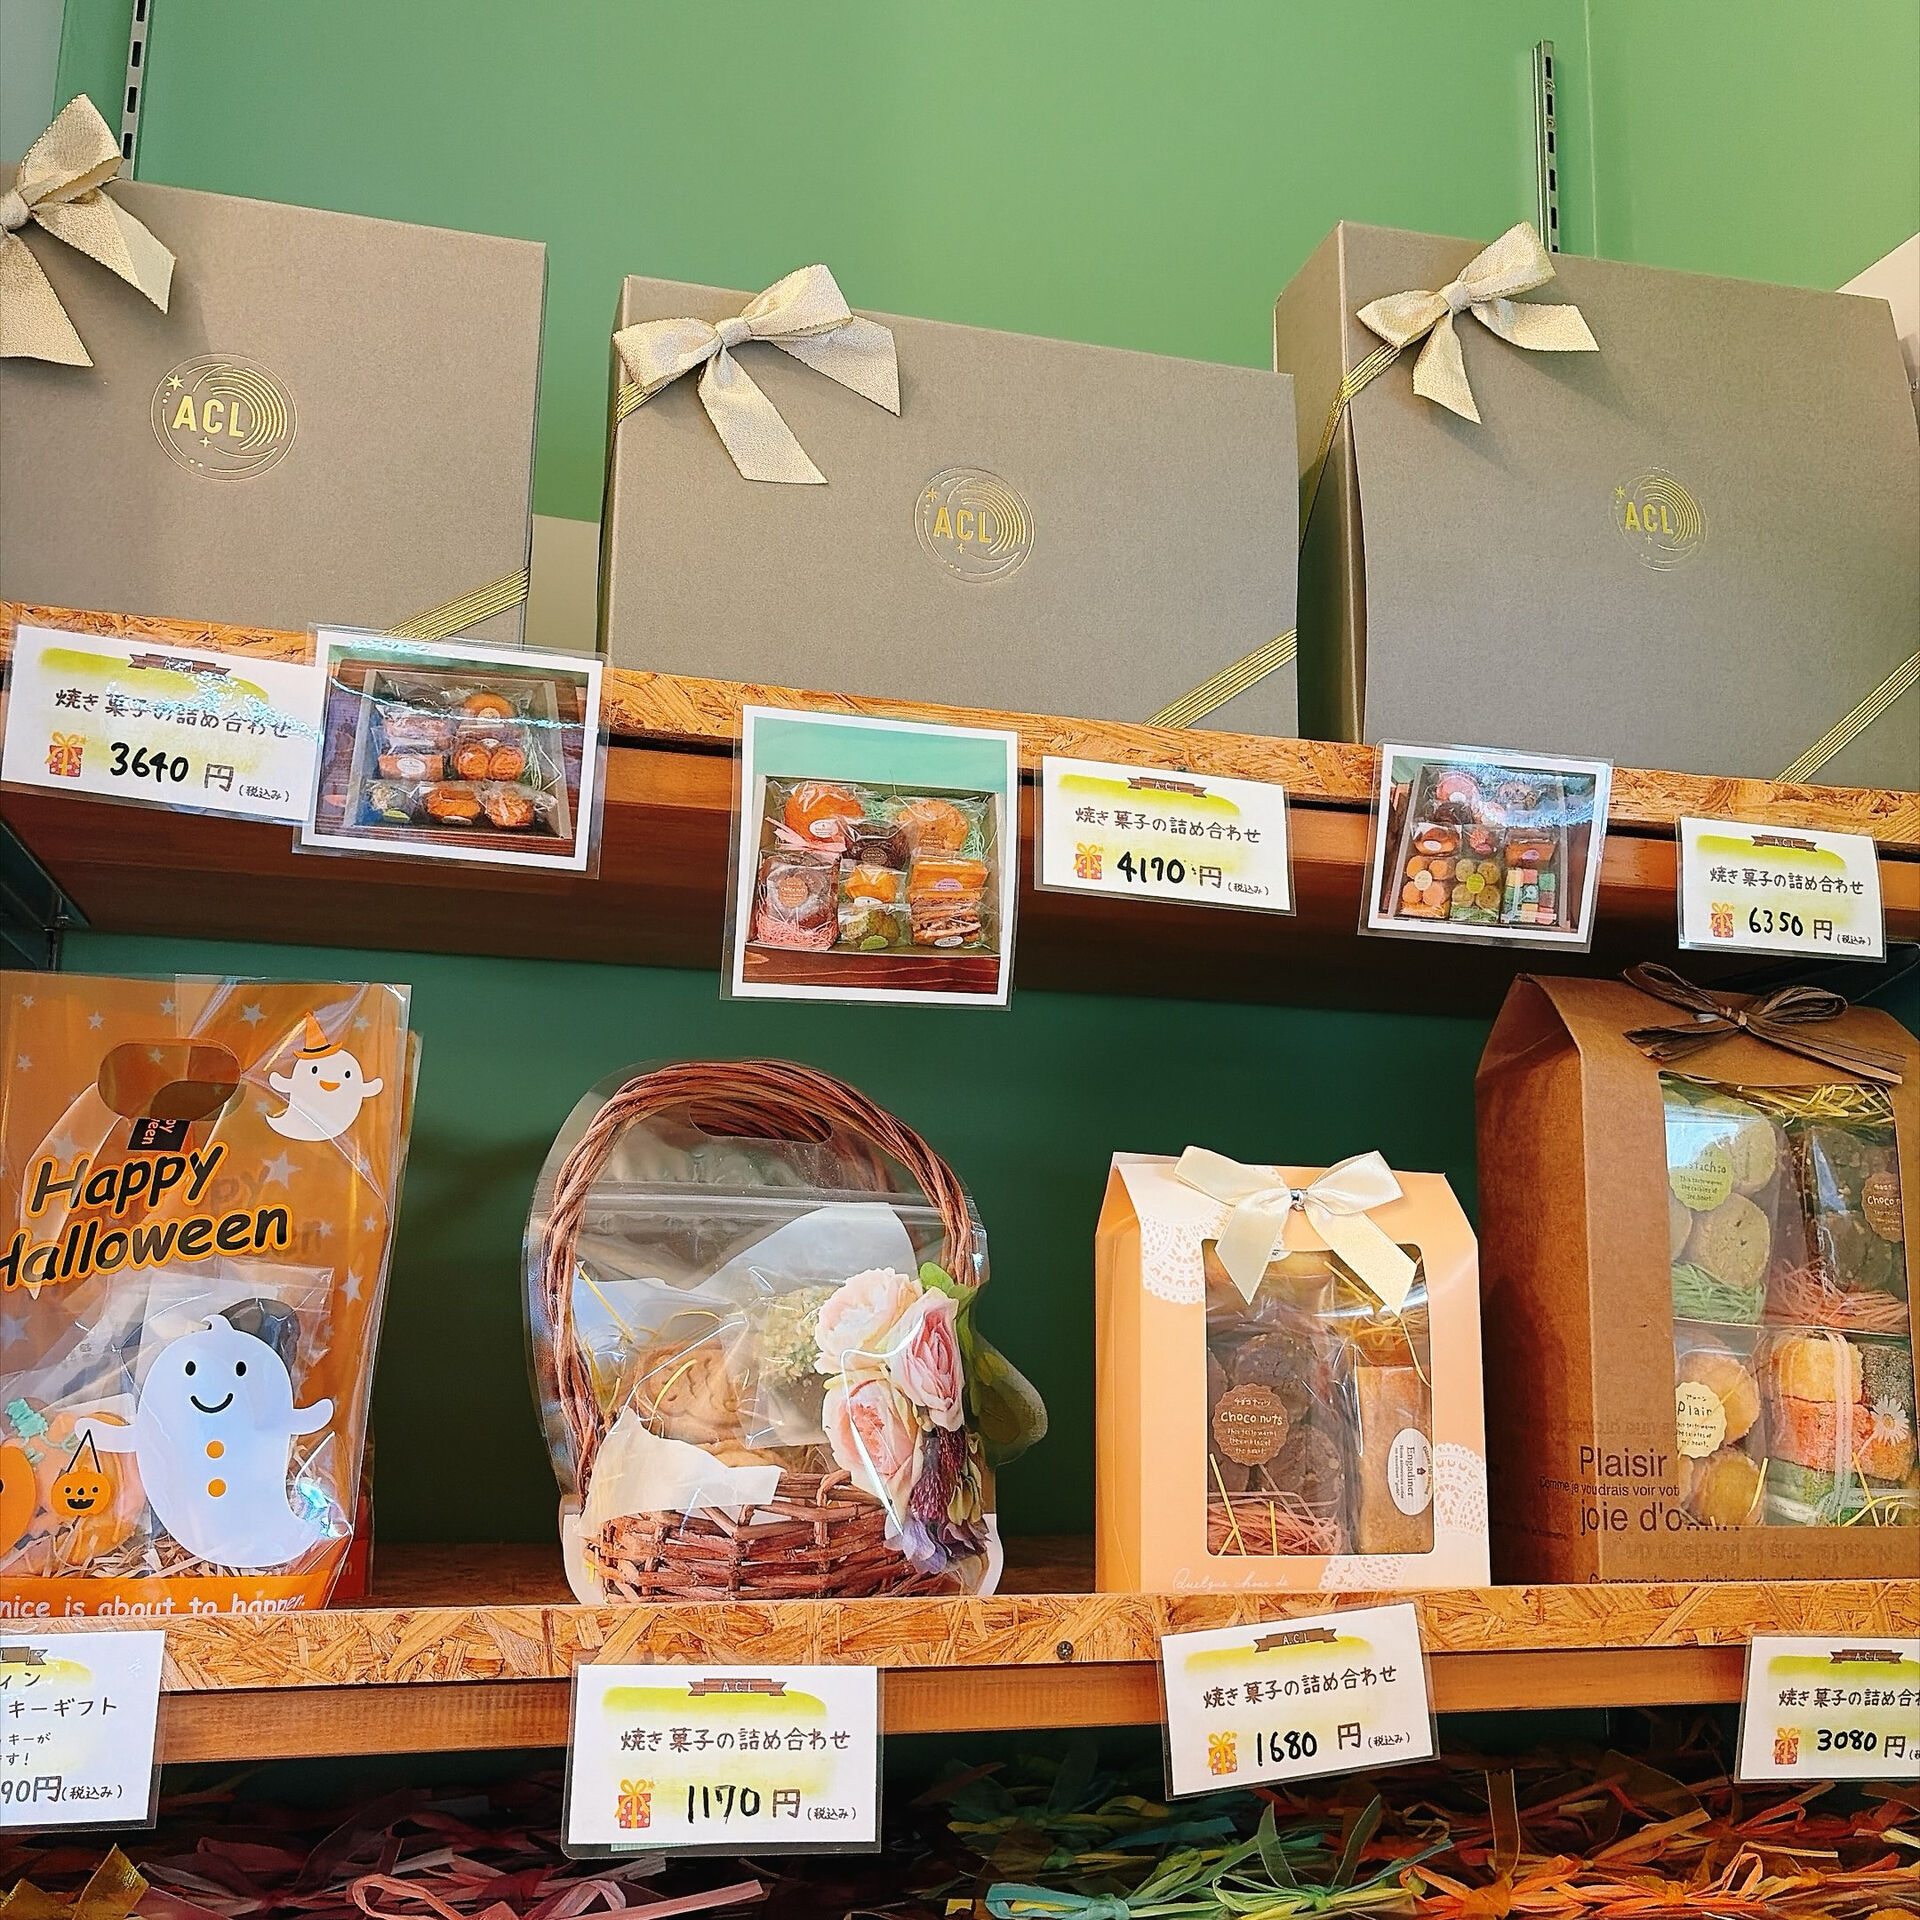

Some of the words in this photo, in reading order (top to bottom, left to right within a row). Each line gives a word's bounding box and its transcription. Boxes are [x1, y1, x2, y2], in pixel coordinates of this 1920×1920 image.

[172, 395, 245, 438] ACL
[933, 506, 992, 543] ACL
[1624, 501, 1674, 535] ACL
[109, 741, 189, 784] 3640
[203, 763, 235, 792] 円
[1074, 806, 1262, 844] 焼き菓子の詰め合わせ
[1116, 851, 1186, 884] 4170
[1198, 865, 1223, 889] 円
[1709, 866, 1864, 895] 焼き菓子の詰め合わせ
[1748, 907, 1804, 937] 6350
[1812, 919, 1833, 941] 円
[29, 1144, 226, 1216] Happy
[1220, 1410, 1257, 1424] Choco
[1260, 1413, 1283, 1426] nuts
[1579, 1445, 1668, 1477] Plaisir
[1581, 1484, 1629, 1496] voudrais
[1634, 1484, 1656, 1496] voir
[1580, 1500, 1628, 1536] joie
[64, 1595, 85, 1617] is
[98, 1595, 176, 1617] about
[189, 1596, 217, 1616] to
[1202, 1665, 1397, 1709] 焼き菓子の詰め合わせ
[620, 1727, 851, 1752] 焼き菓子の詰め合わせ
[1256, 1730, 1318, 1767] 1680
[1337, 1722, 1362, 1750] 円
[1817, 1729, 1878, 1751] 3080
[1884, 1736, 1906, 1758] 円
[687, 1784, 761, 1825] 1170
[772, 1788, 801, 1819] 円
